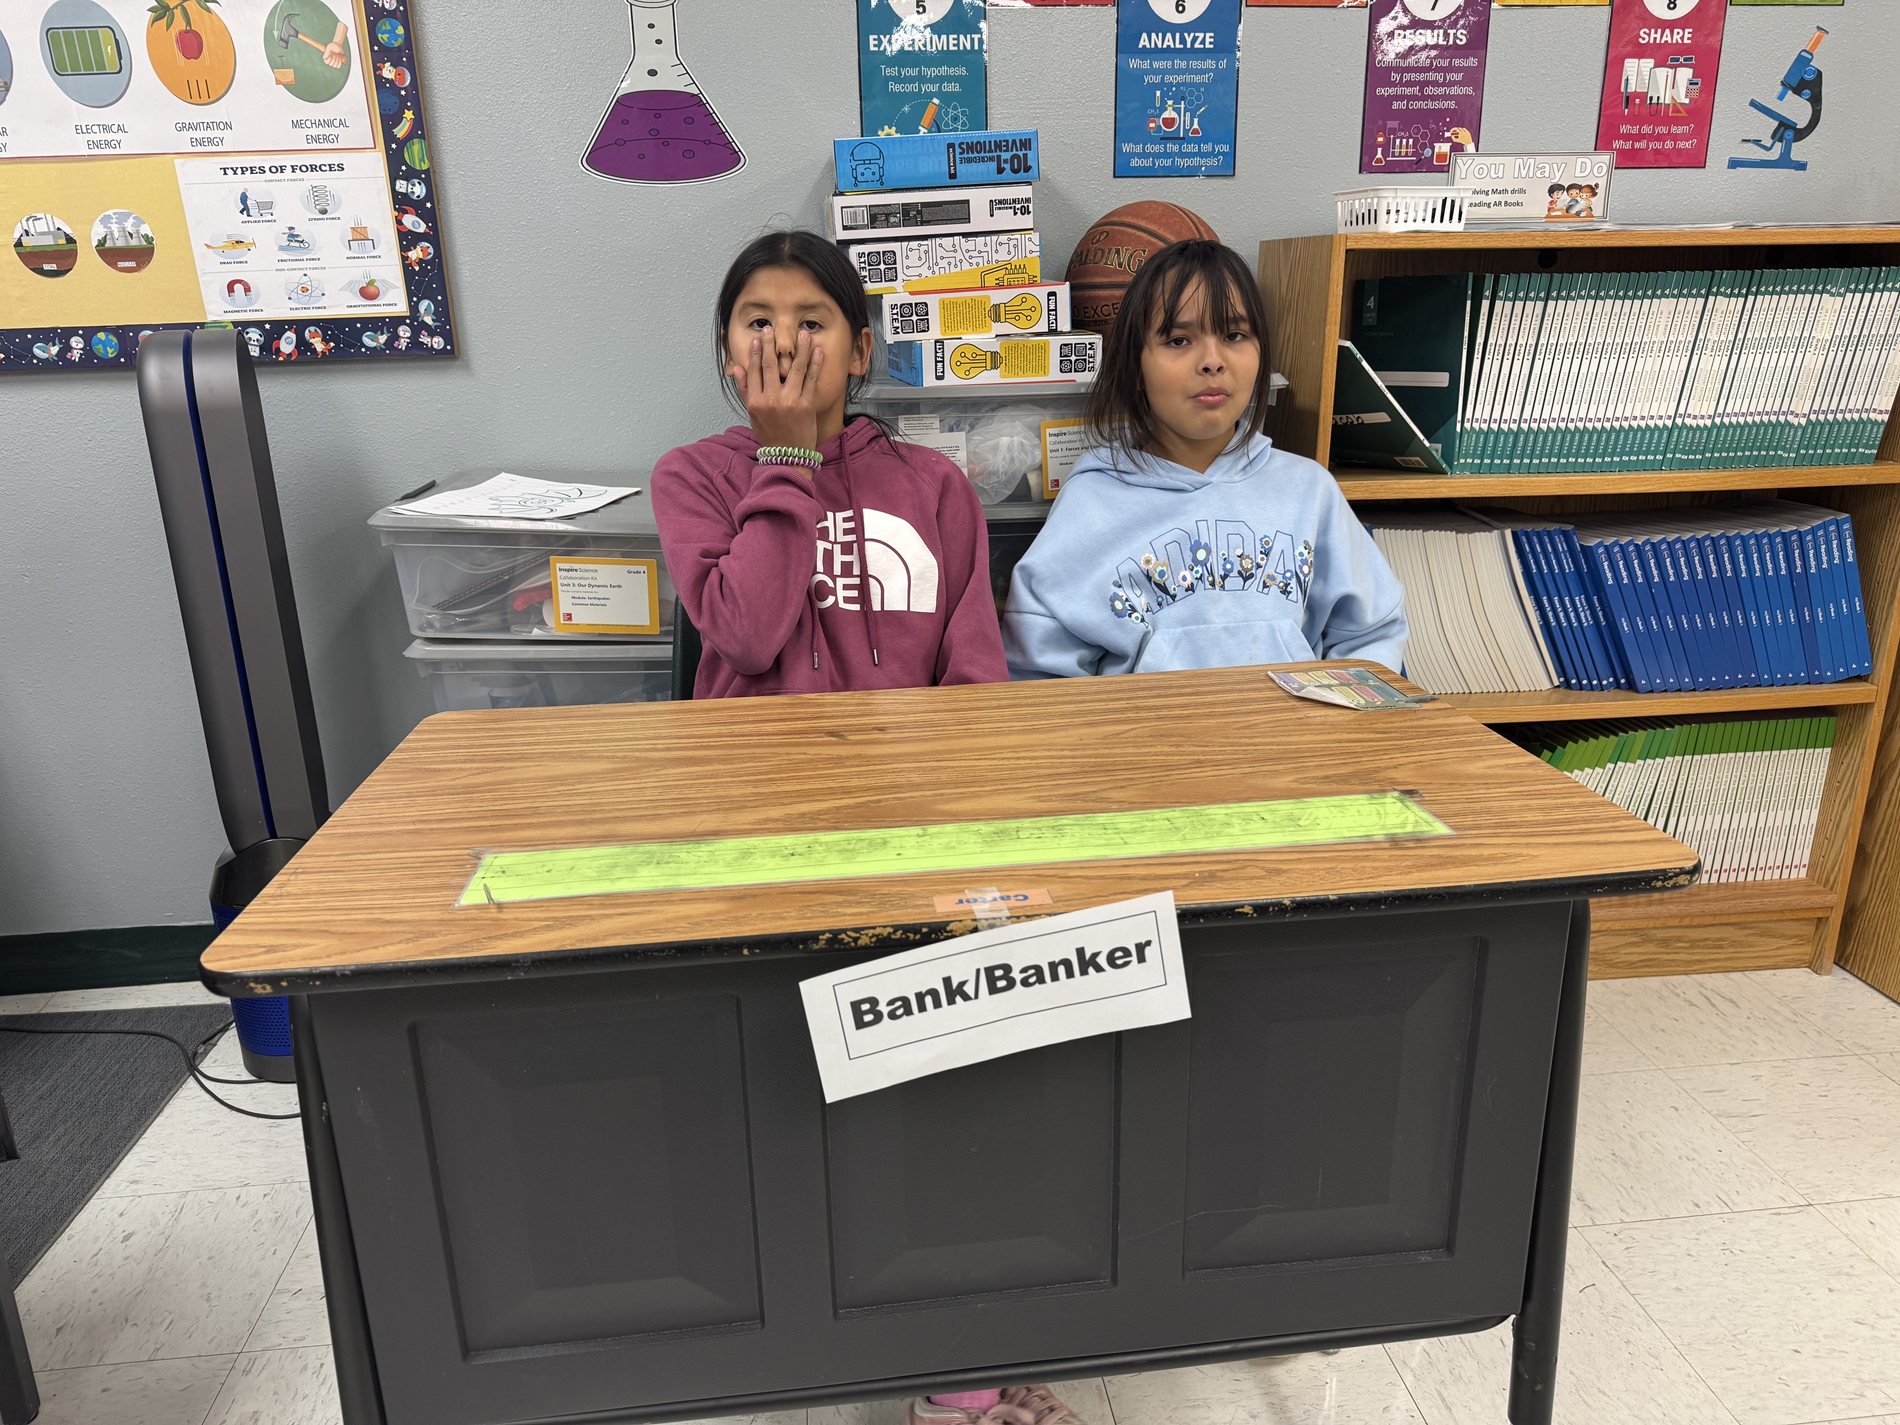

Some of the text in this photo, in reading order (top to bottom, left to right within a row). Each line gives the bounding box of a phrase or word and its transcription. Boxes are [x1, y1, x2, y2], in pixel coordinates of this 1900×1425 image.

[916, 0, 926, 14] 5
[1175, 0, 1186, 14] 6
[1138, 32, 1214, 48] ANALYZE
[1394, 30, 1467, 45] RESULTS
[1639, 28, 1692, 43] SHARE
[869, 34, 981, 51] EXPERIMENT
[1129, 58, 1227, 68] What were the results of
[1376, 57, 1478, 68] Communicate your results
[880, 65, 968, 77] Test your hypothesis.
[1391, 72, 1463, 82] by presenting your
[1144, 73, 1213, 85] your experiment?
[889, 82, 961, 94] Record your data.
[1376, 85, 1475, 96] experiment, observations,
[1392, 99, 1457, 109] and conclusions.
[75, 124, 128, 135] ELECTRICAL
[175, 121, 232, 132] GRAVITATION
[292, 118, 349, 130] MECHANICAL
[1620, 124, 1694, 135] What did you learn?
[87, 138, 122, 150] ENERGY
[190, 136, 224, 148] ENERGY
[306, 134, 340, 144] ENERGY
[1613, 139, 1697, 151] What will you do next?
[958, 138, 1032, 155] INVENTIONS
[1122, 142, 1229, 154] What does the data tell you
[959, 155, 996, 164] INCREDIBLE
[1130, 156, 1223, 168] about your hypothesis?
[220, 163, 345, 176] TYPES OF FORCES
[1456, 157, 1608, 183] You May Do
[994, 197, 1031, 206] INVENTIONS
[1367, 296, 1374, 309] 4
[1603, 561, 1613, 585] Reading
[1634, 559, 1643, 583] Reading
[1666, 558, 1675, 581] Reading
[1694, 556, 1703, 580] Reading
[955, 894, 1029, 905] Carter
[850, 940, 1152, 1031] Bank/Banker
